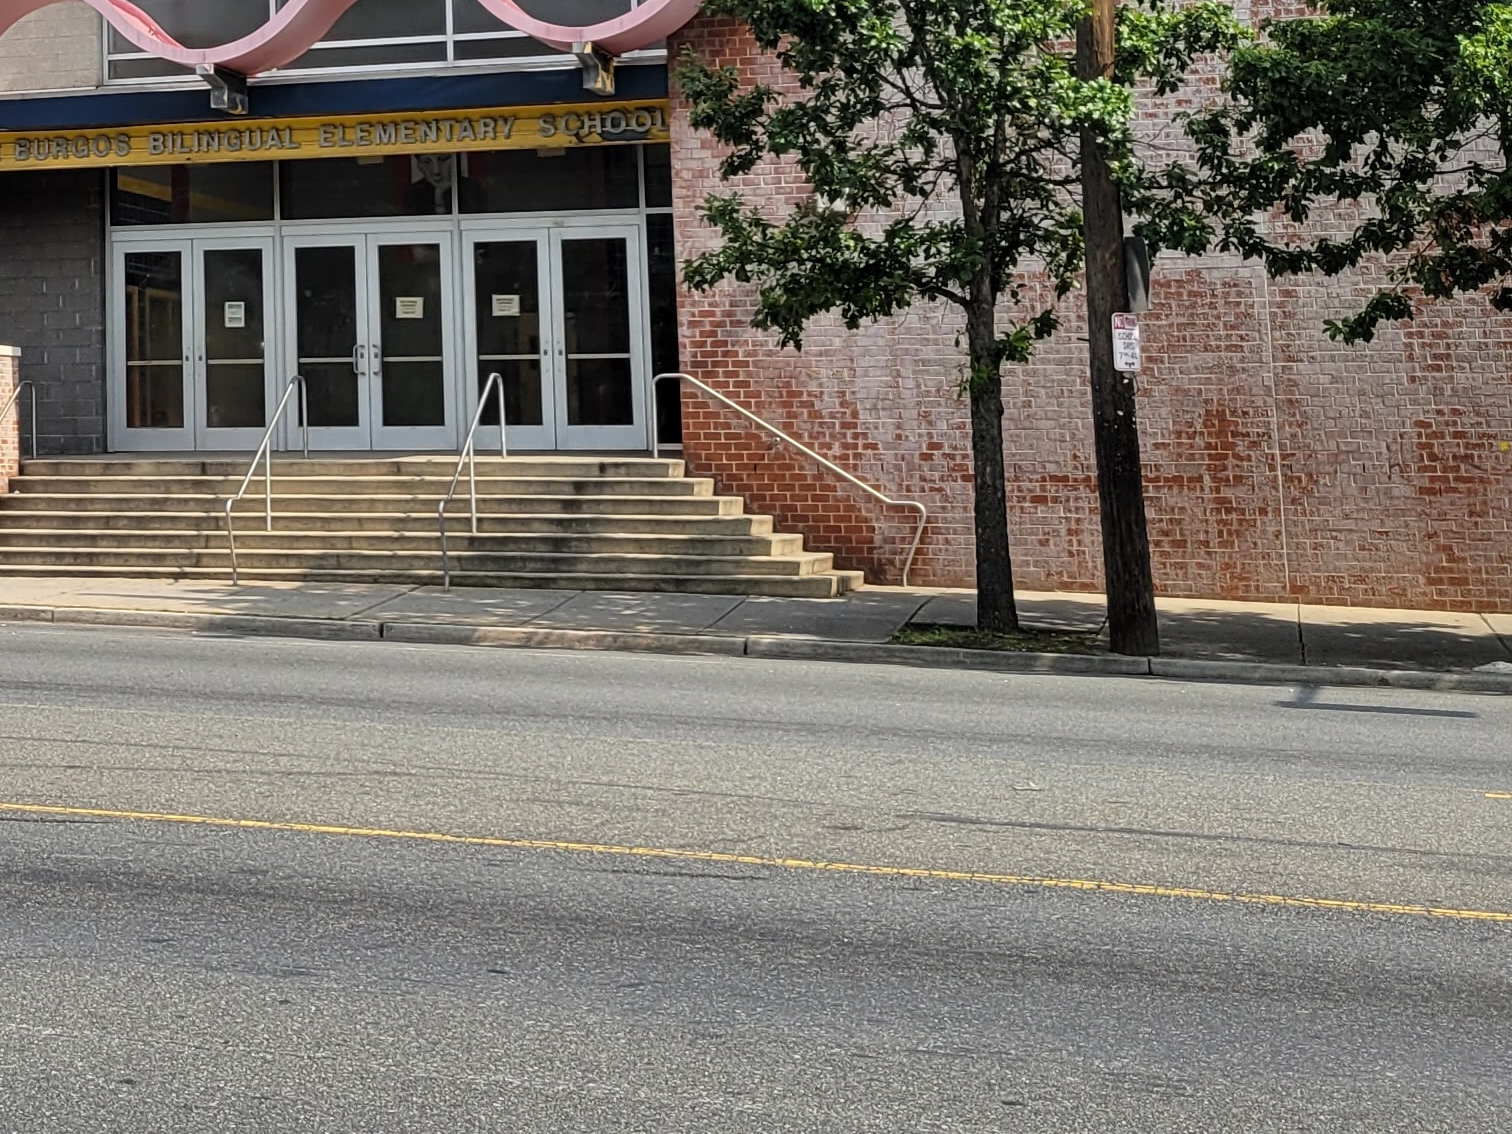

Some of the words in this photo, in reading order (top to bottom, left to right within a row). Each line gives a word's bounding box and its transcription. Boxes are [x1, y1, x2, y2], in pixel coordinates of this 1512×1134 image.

[14, 133, 131, 161] BURGOS
[148, 126, 300, 156] BILINGUAL
[319, 116, 516, 148] ELEMENTARY
[539, 109, 669, 138] SCHOOL
